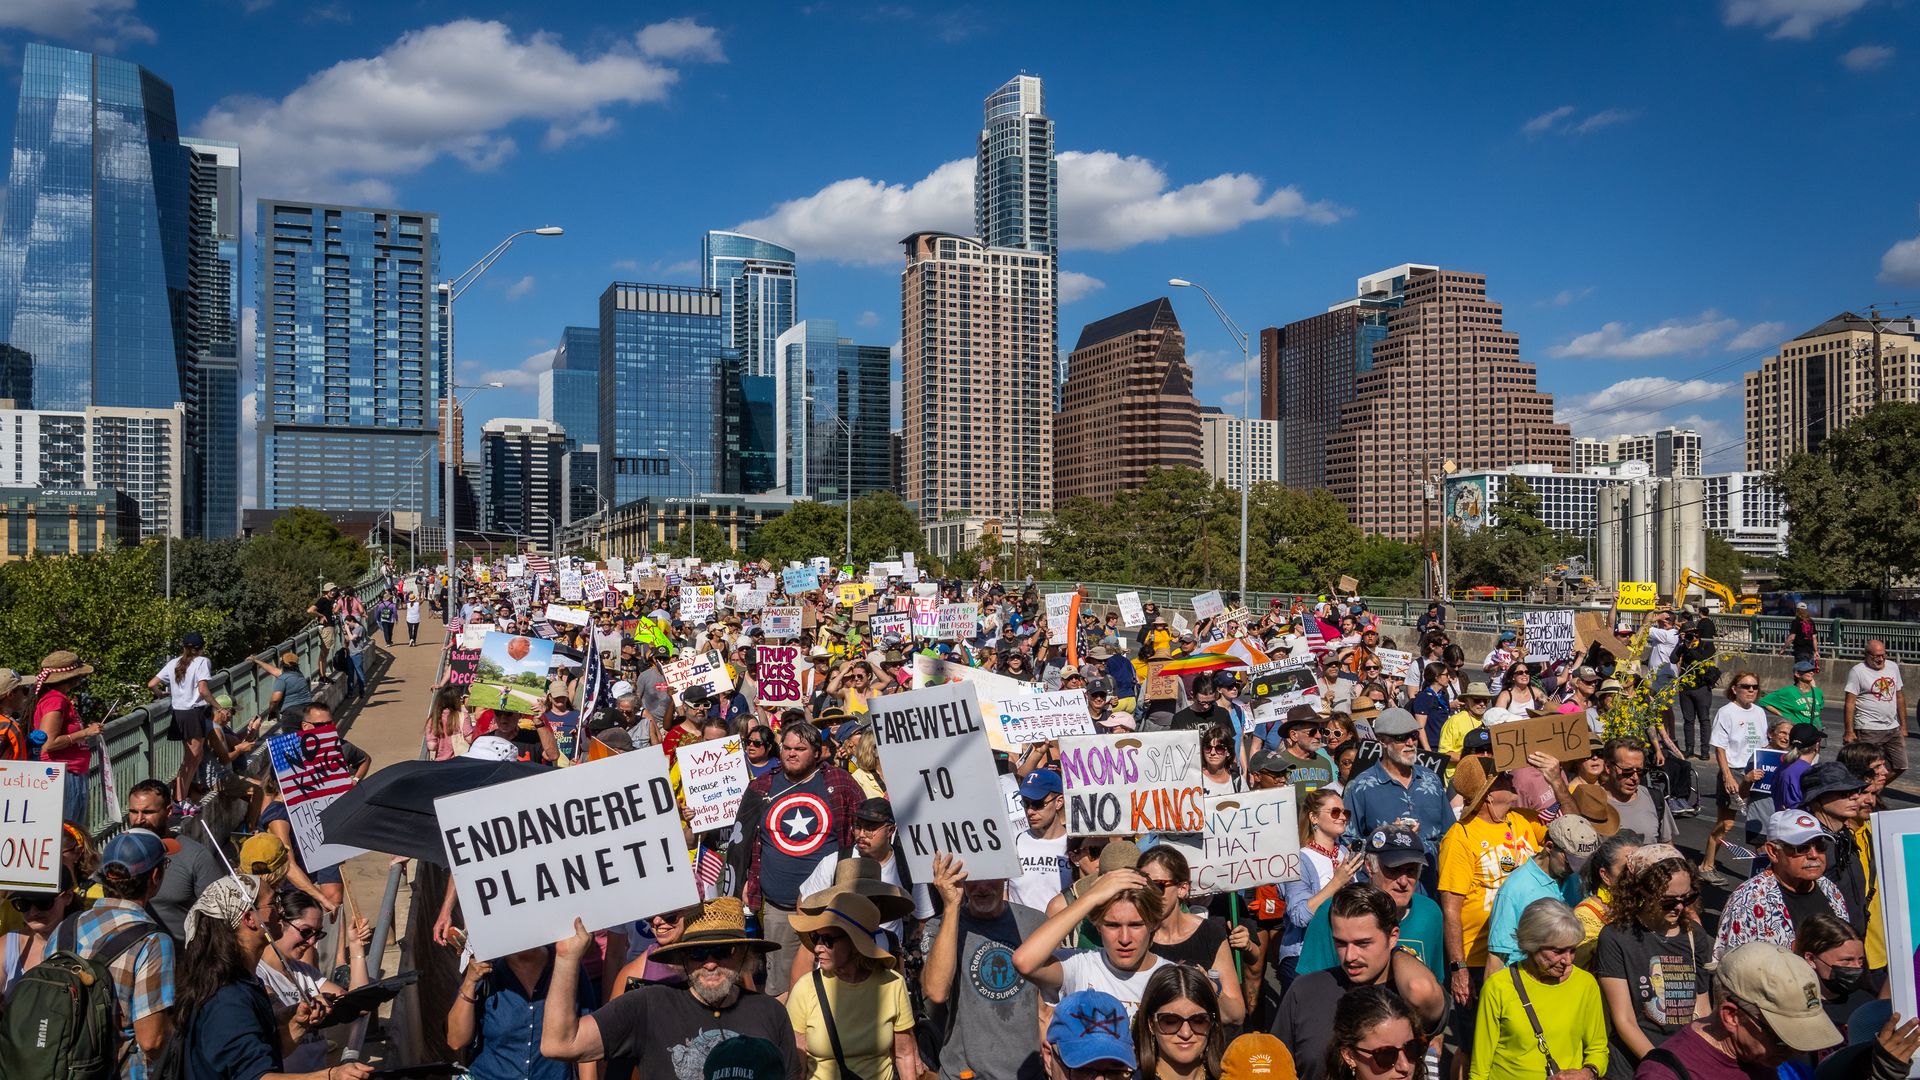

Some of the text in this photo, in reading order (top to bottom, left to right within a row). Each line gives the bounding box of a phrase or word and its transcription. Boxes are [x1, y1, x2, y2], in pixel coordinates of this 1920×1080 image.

[681, 587, 693, 597] NO
[1621, 584, 1652, 592] GO FOX
[697, 602, 714, 610] PEDO
[1525, 611, 1574, 626] WHEN CRUELTY
[872, 626, 882, 636] WE
[1525, 625, 1552, 641] BECOMES
[1553, 623, 1575, 640] NORMAL
[757, 646, 798, 663] TRUMP
[1524, 640, 1560, 656] COMPASSION
[468, 661, 476, 671] by
[663, 656, 697, 675] I ONLY
[666, 662, 712, 685] LIKE ICE
[756, 663, 797, 680] FUCKS
[1250, 657, 1299, 673] RELEASE THE FILES
[679, 675, 707, 690] IN MY
[758, 680, 801, 701] KIDS
[998, 695, 1083, 713] This Is What
[871, 699, 980, 746] FAREWELL
[1006, 731, 1046, 744] Looks
[284, 733, 320, 771] NO
[691, 750, 722, 768] Why
[690, 757, 742, 779] PROTEST?
[1060, 743, 1197, 789] MOMS SAY
[4, 772, 49, 790] ustice
[688, 775, 737, 795] Because it's
[919, 766, 955, 801] TO
[1027, 772, 1038, 784] T
[702, 786, 742, 803] Easier than
[4, 799, 36, 824] LL
[692, 803, 720, 817] hiding
[693, 808, 738, 827] in the atti
[1070, 786, 1204, 833] NO KINGS
[445, 776, 675, 867] ENDANGERED
[1796, 815, 1815, 828] C
[908, 818, 1002, 856] KINGS
[1202, 831, 1261, 860] THAT
[475, 837, 675, 916] PLANET!
[970, 942, 991, 972] Reebok
[978, 985, 1020, 1000] 2015 SUPER
[1665, 981, 1682, 990] WOULD
[1665, 990, 1686, 998] DENYING
[1666, 999, 1677, 1007] FULL
[1666, 1016, 1678, 1025] FULL
[36, 1018, 48, 1049] THULE
[712, 1066, 754, 1080] BLUE HOLE
